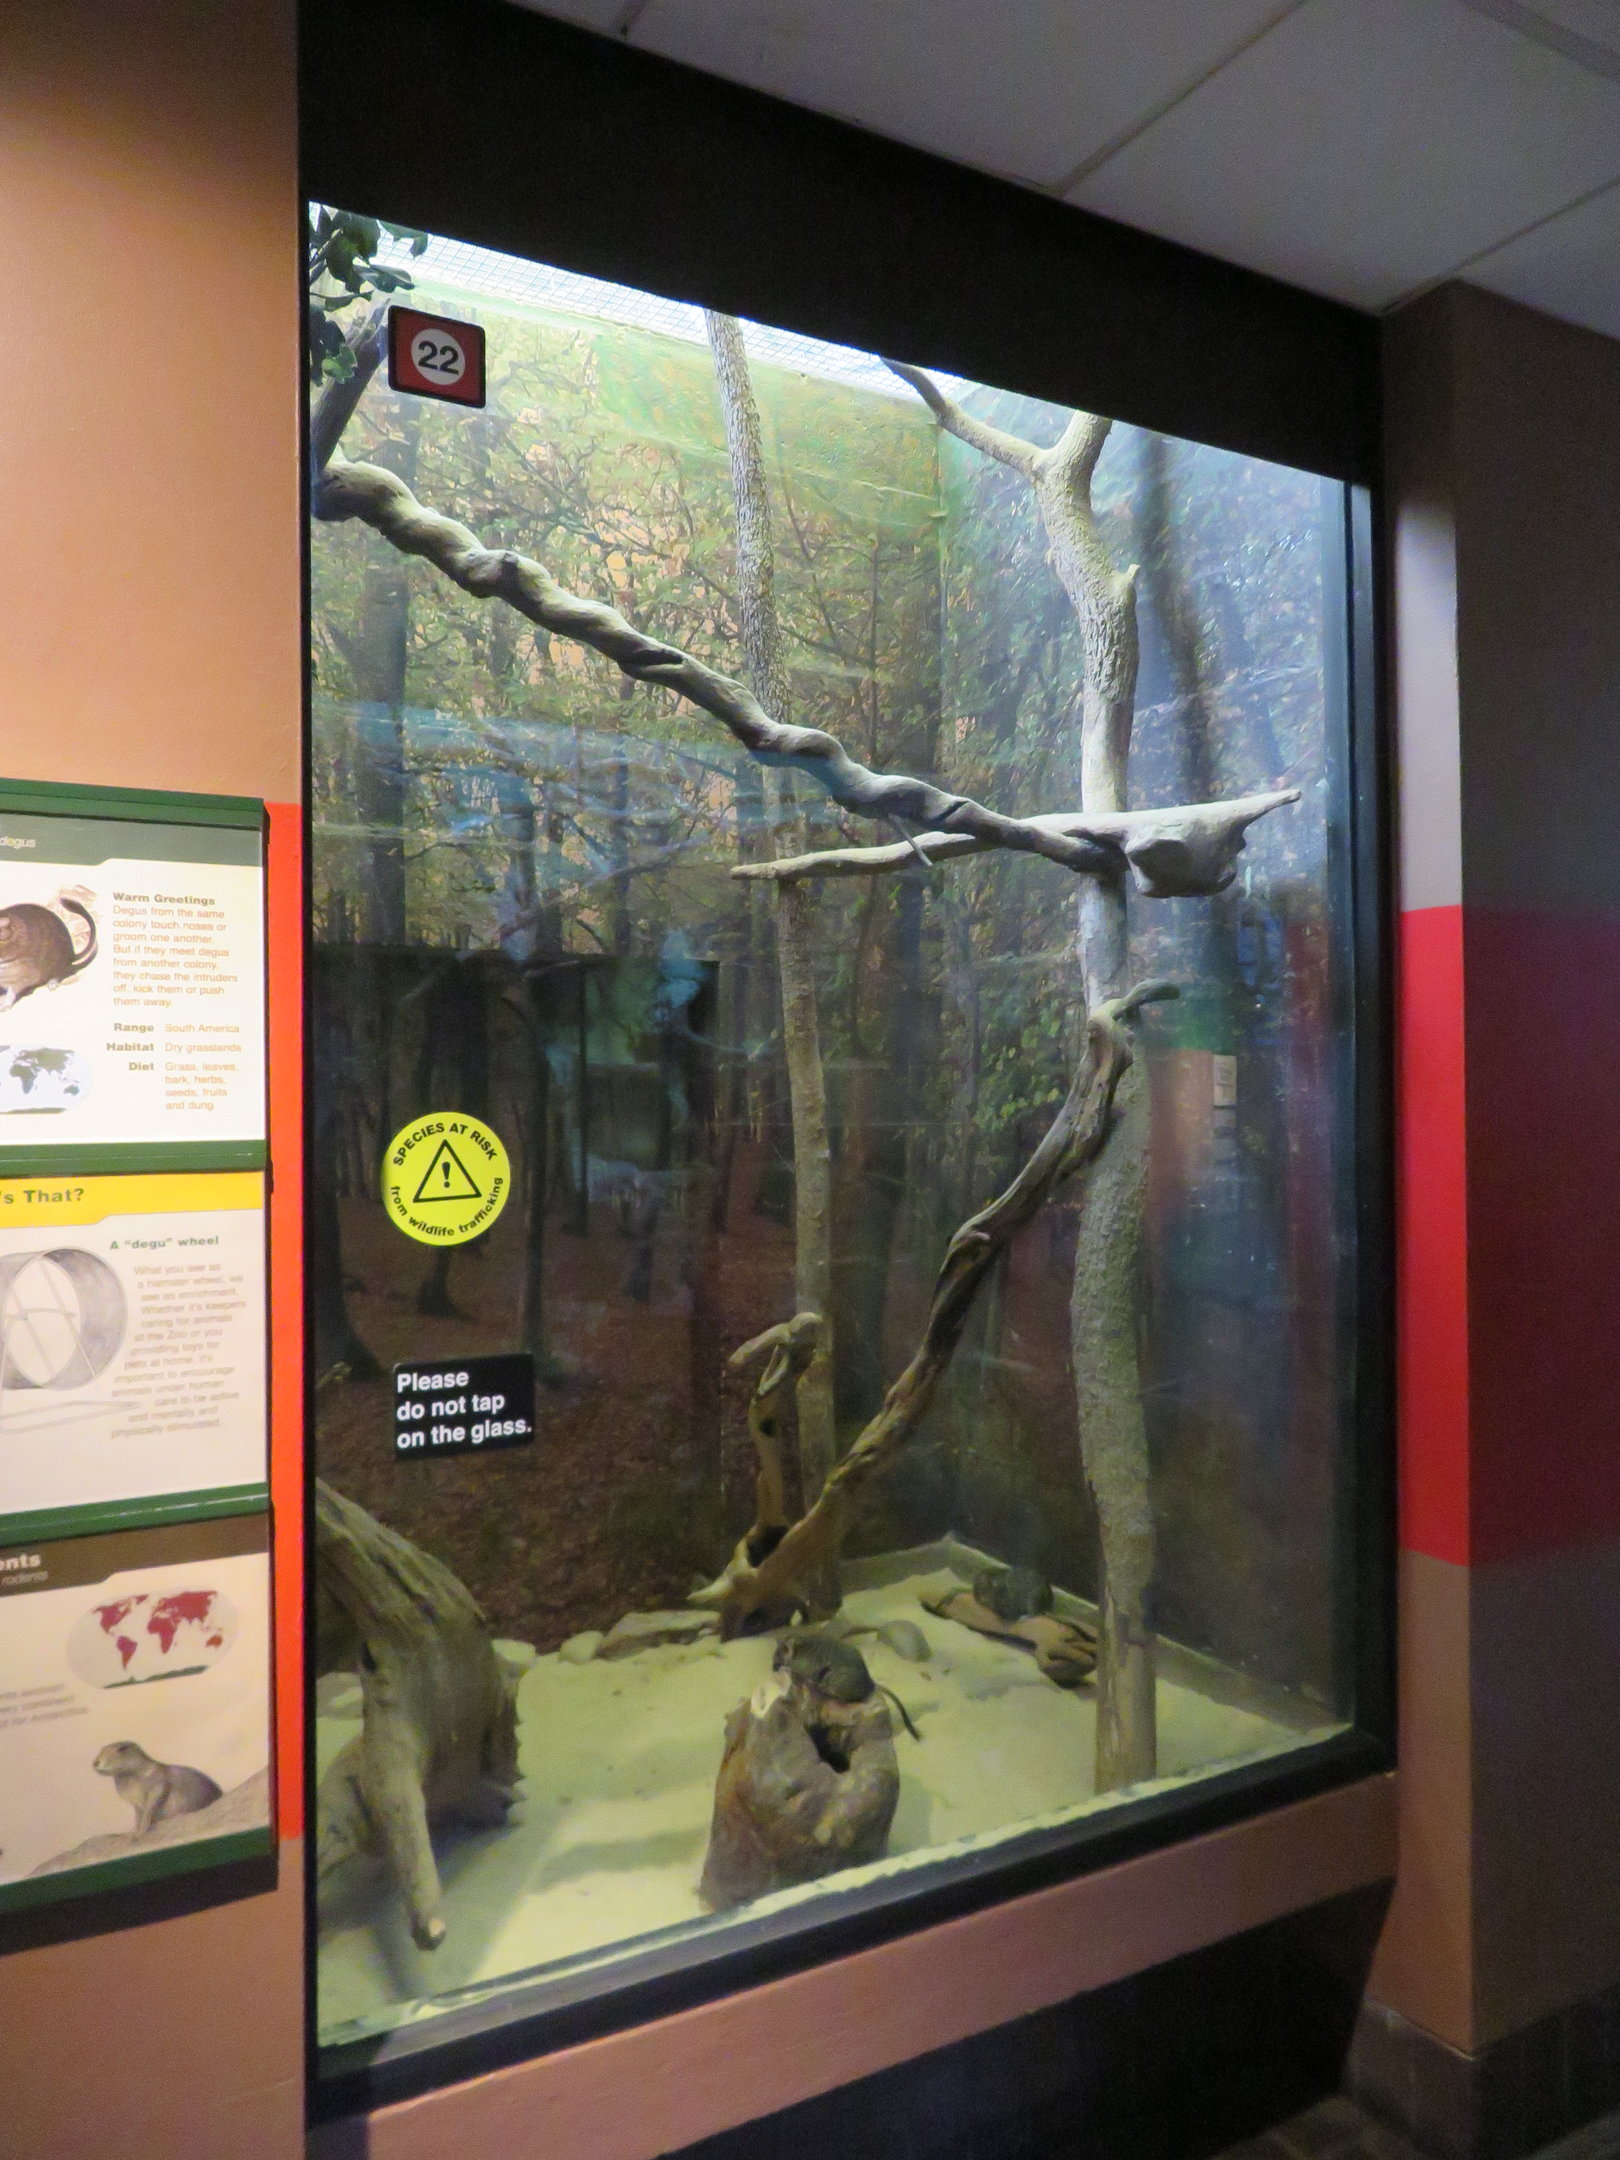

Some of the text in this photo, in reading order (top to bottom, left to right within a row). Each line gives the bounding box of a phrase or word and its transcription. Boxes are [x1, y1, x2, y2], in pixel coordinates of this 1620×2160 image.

[418, 340, 459, 376] 22
[112, 891, 215, 906] Warm Greetings
[113, 905, 225, 918] Degus from the same
[112, 919, 147, 930] colony
[151, 920, 179, 929] touch
[183, 923, 214, 931] noses
[113, 933, 147, 942] groom
[150, 934, 170, 942] one
[113, 944, 230, 958] But if they meet degus
[113, 958, 137, 966] from
[141, 959, 180, 968] another
[113, 971, 238, 982] they chase the intruders
[133, 984, 153, 993] kick
[157, 985, 183, 994] them
[199, 986, 225, 996] push
[113, 997, 140, 1006] them
[113, 1022, 240, 1034] Range South America
[106, 1042, 242, 1054] Habitat Dry grasslands
[128, 1062, 154, 1071] Diet
[202, 1087, 227, 1096] fruits
[165, 1101, 214, 1112] and dung
[393, 1122, 498, 1166] SPECIES AT RISK
[23, 1188, 84, 1203] That?
[390, 1177, 503, 1236] from wildlife trafficking
[109, 1240, 119, 1250] A
[178, 1235, 219, 1246] wheel
[397, 1371, 469, 1393] Please
[396, 1394, 506, 1421] do not tap
[396, 1418, 532, 1449] on the glass.
